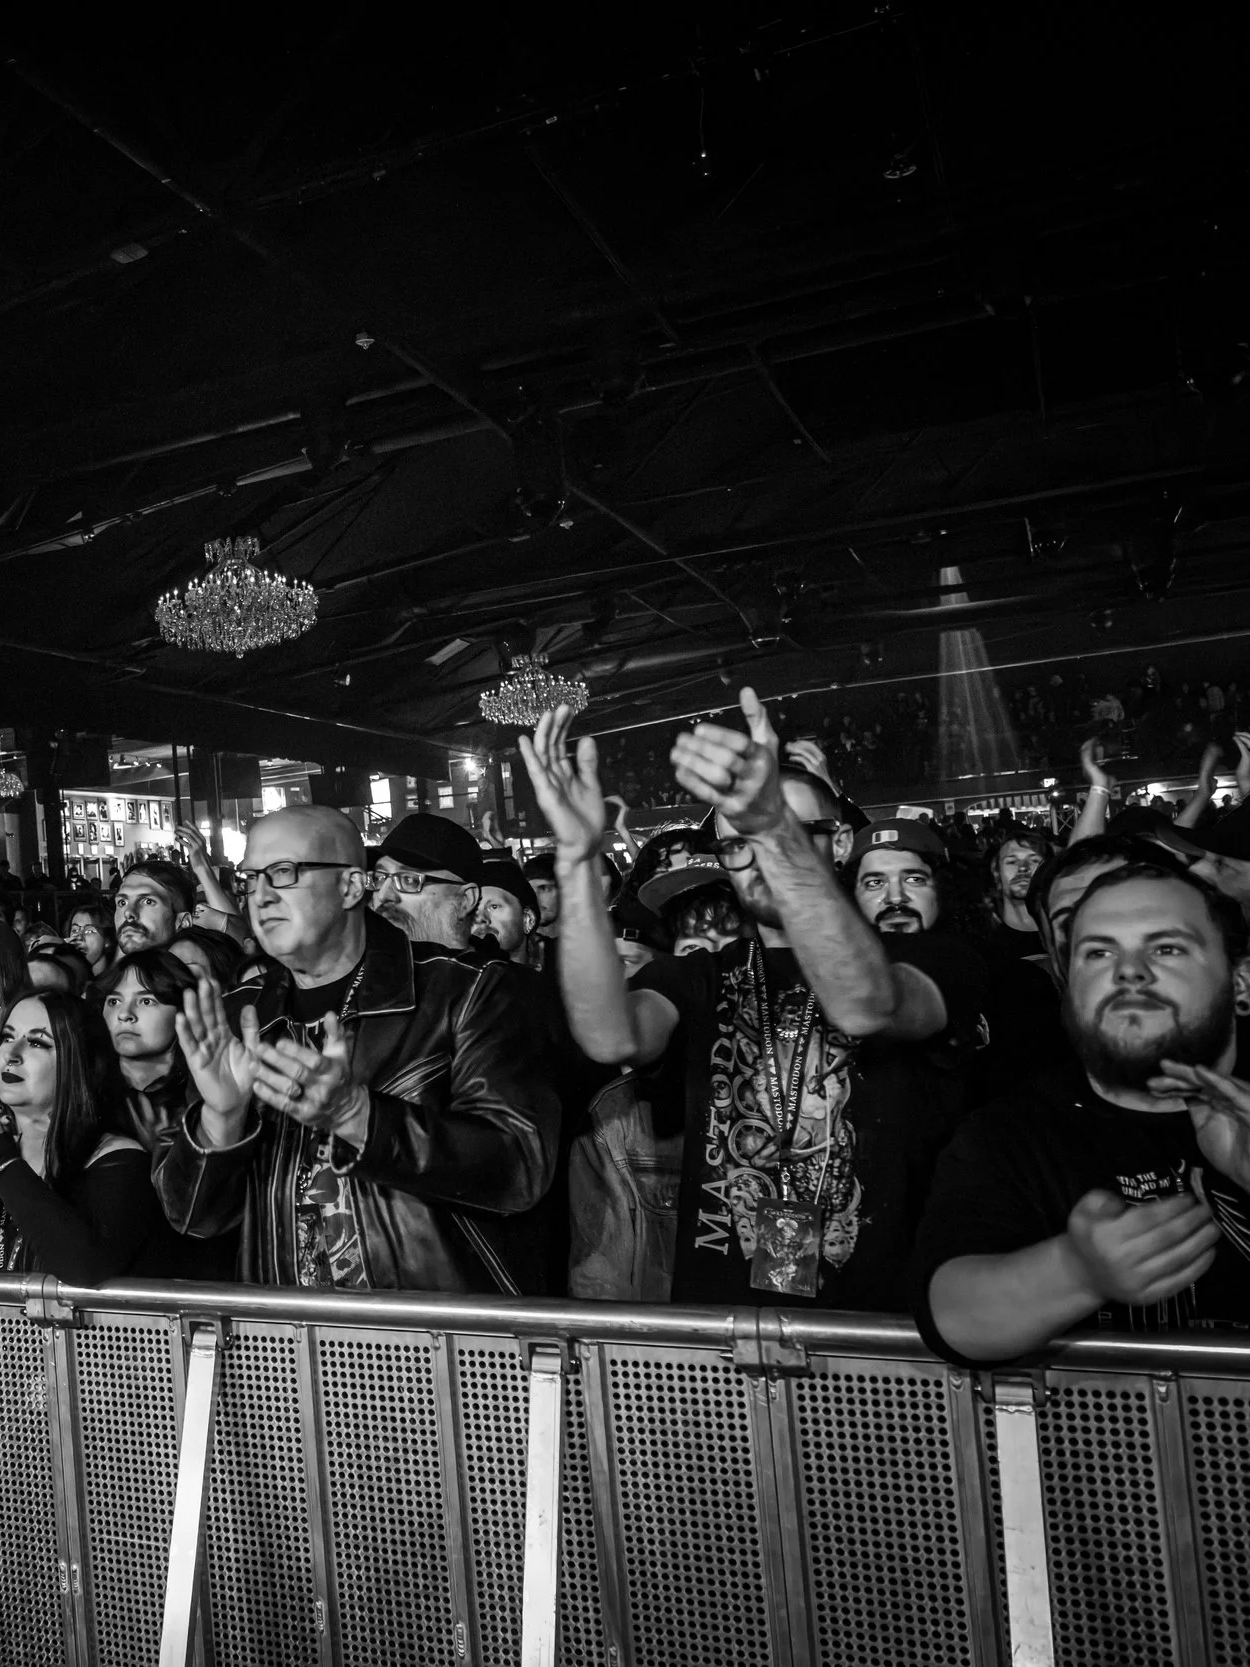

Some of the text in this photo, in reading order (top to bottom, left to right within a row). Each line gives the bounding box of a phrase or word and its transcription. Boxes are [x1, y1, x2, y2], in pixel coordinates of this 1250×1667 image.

[352, 964, 365, 988] MAST
[761, 1002, 774, 1055] MASTODON
[801, 992, 816, 1036] MASTOD
[769, 1076, 784, 1133] MASTODO
[788, 1055, 803, 1112] MASTODON
[1136, 1171, 1157, 1182] THE
